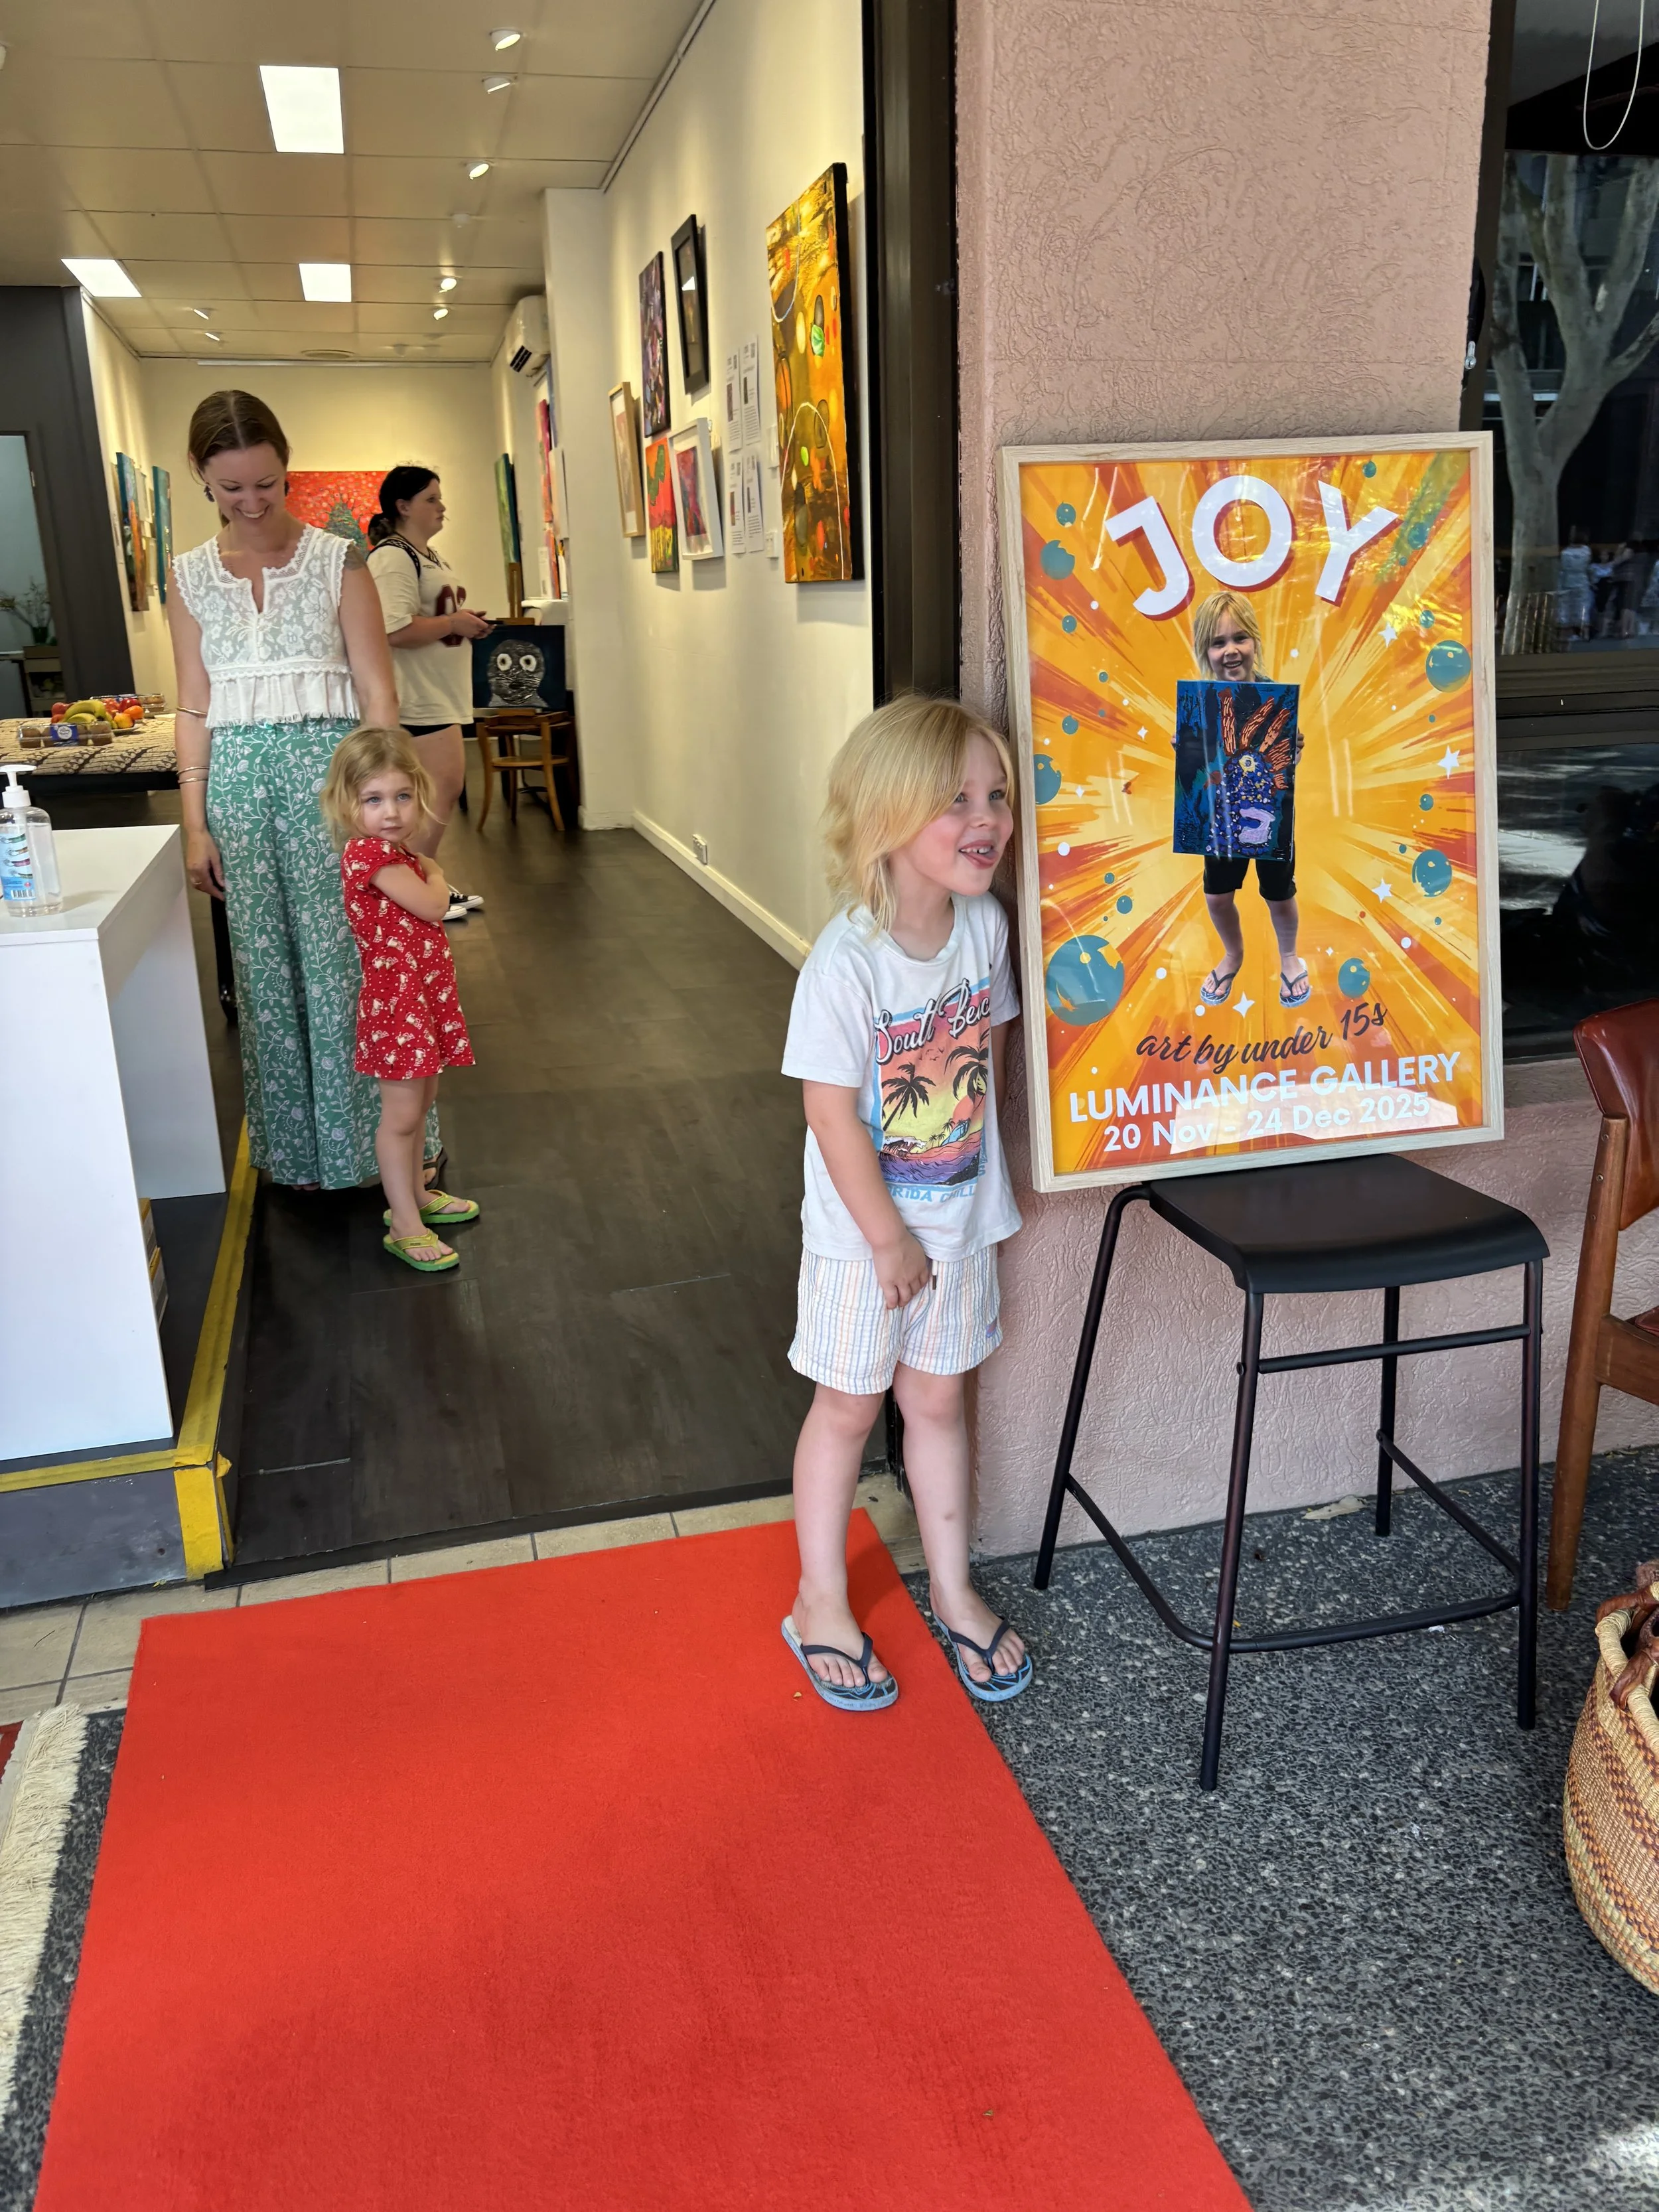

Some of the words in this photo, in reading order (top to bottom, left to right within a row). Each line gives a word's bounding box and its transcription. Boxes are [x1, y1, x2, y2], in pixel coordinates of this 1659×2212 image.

[1104, 475, 1404, 621] JOY
[1136, 1034, 1192, 1063] art
[1192, 1034, 1238, 1075] by
[1241, 1025, 1333, 1063] under
[1340, 1001, 1388, 1041] 15s
[1069, 1069, 1298, 1123] LUMINANCE
[1309, 1051, 1461, 1096] GALLERY
[1104, 1123, 1141, 1152] 20
[1152, 1119, 1214, 1147] Nov
[1247, 1106, 1283, 1136] 24
[1293, 1104, 1351, 1132] Dec
[1358, 1091, 1431, 1124] 2025
